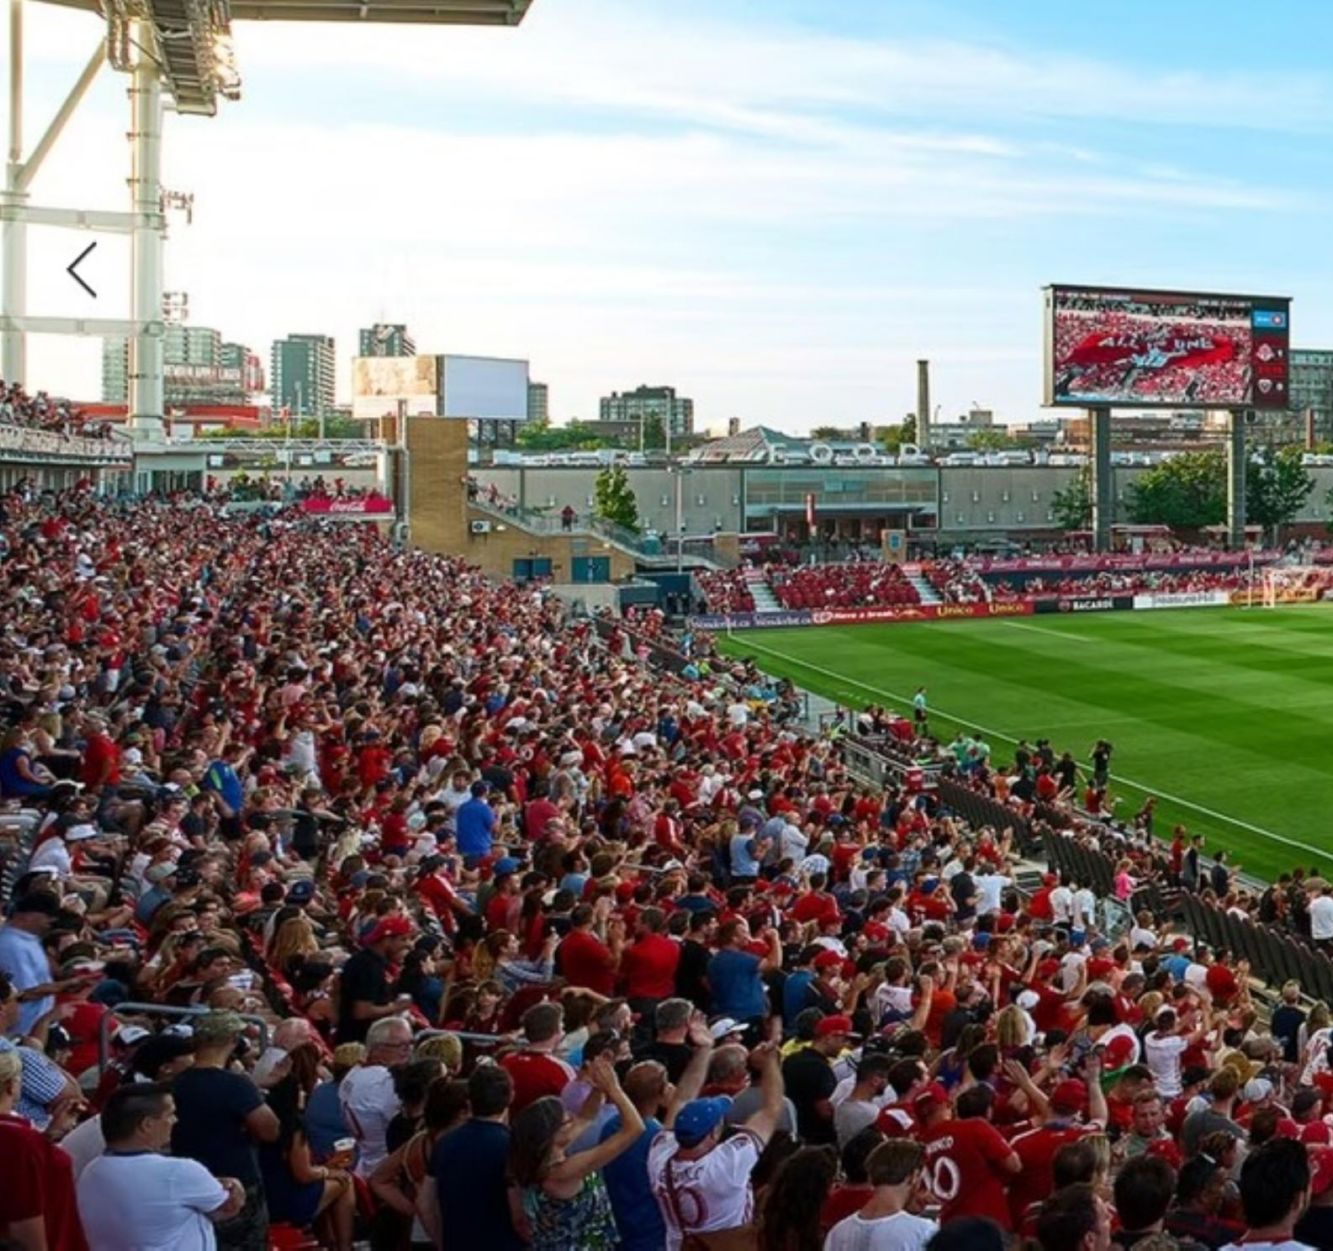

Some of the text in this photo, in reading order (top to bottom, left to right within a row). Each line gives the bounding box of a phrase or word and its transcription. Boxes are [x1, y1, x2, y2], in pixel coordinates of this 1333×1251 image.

[989, 603, 1024, 613] Unico
[1073, 600, 1114, 610] BACARDI
[937, 606, 973, 616] Unico
